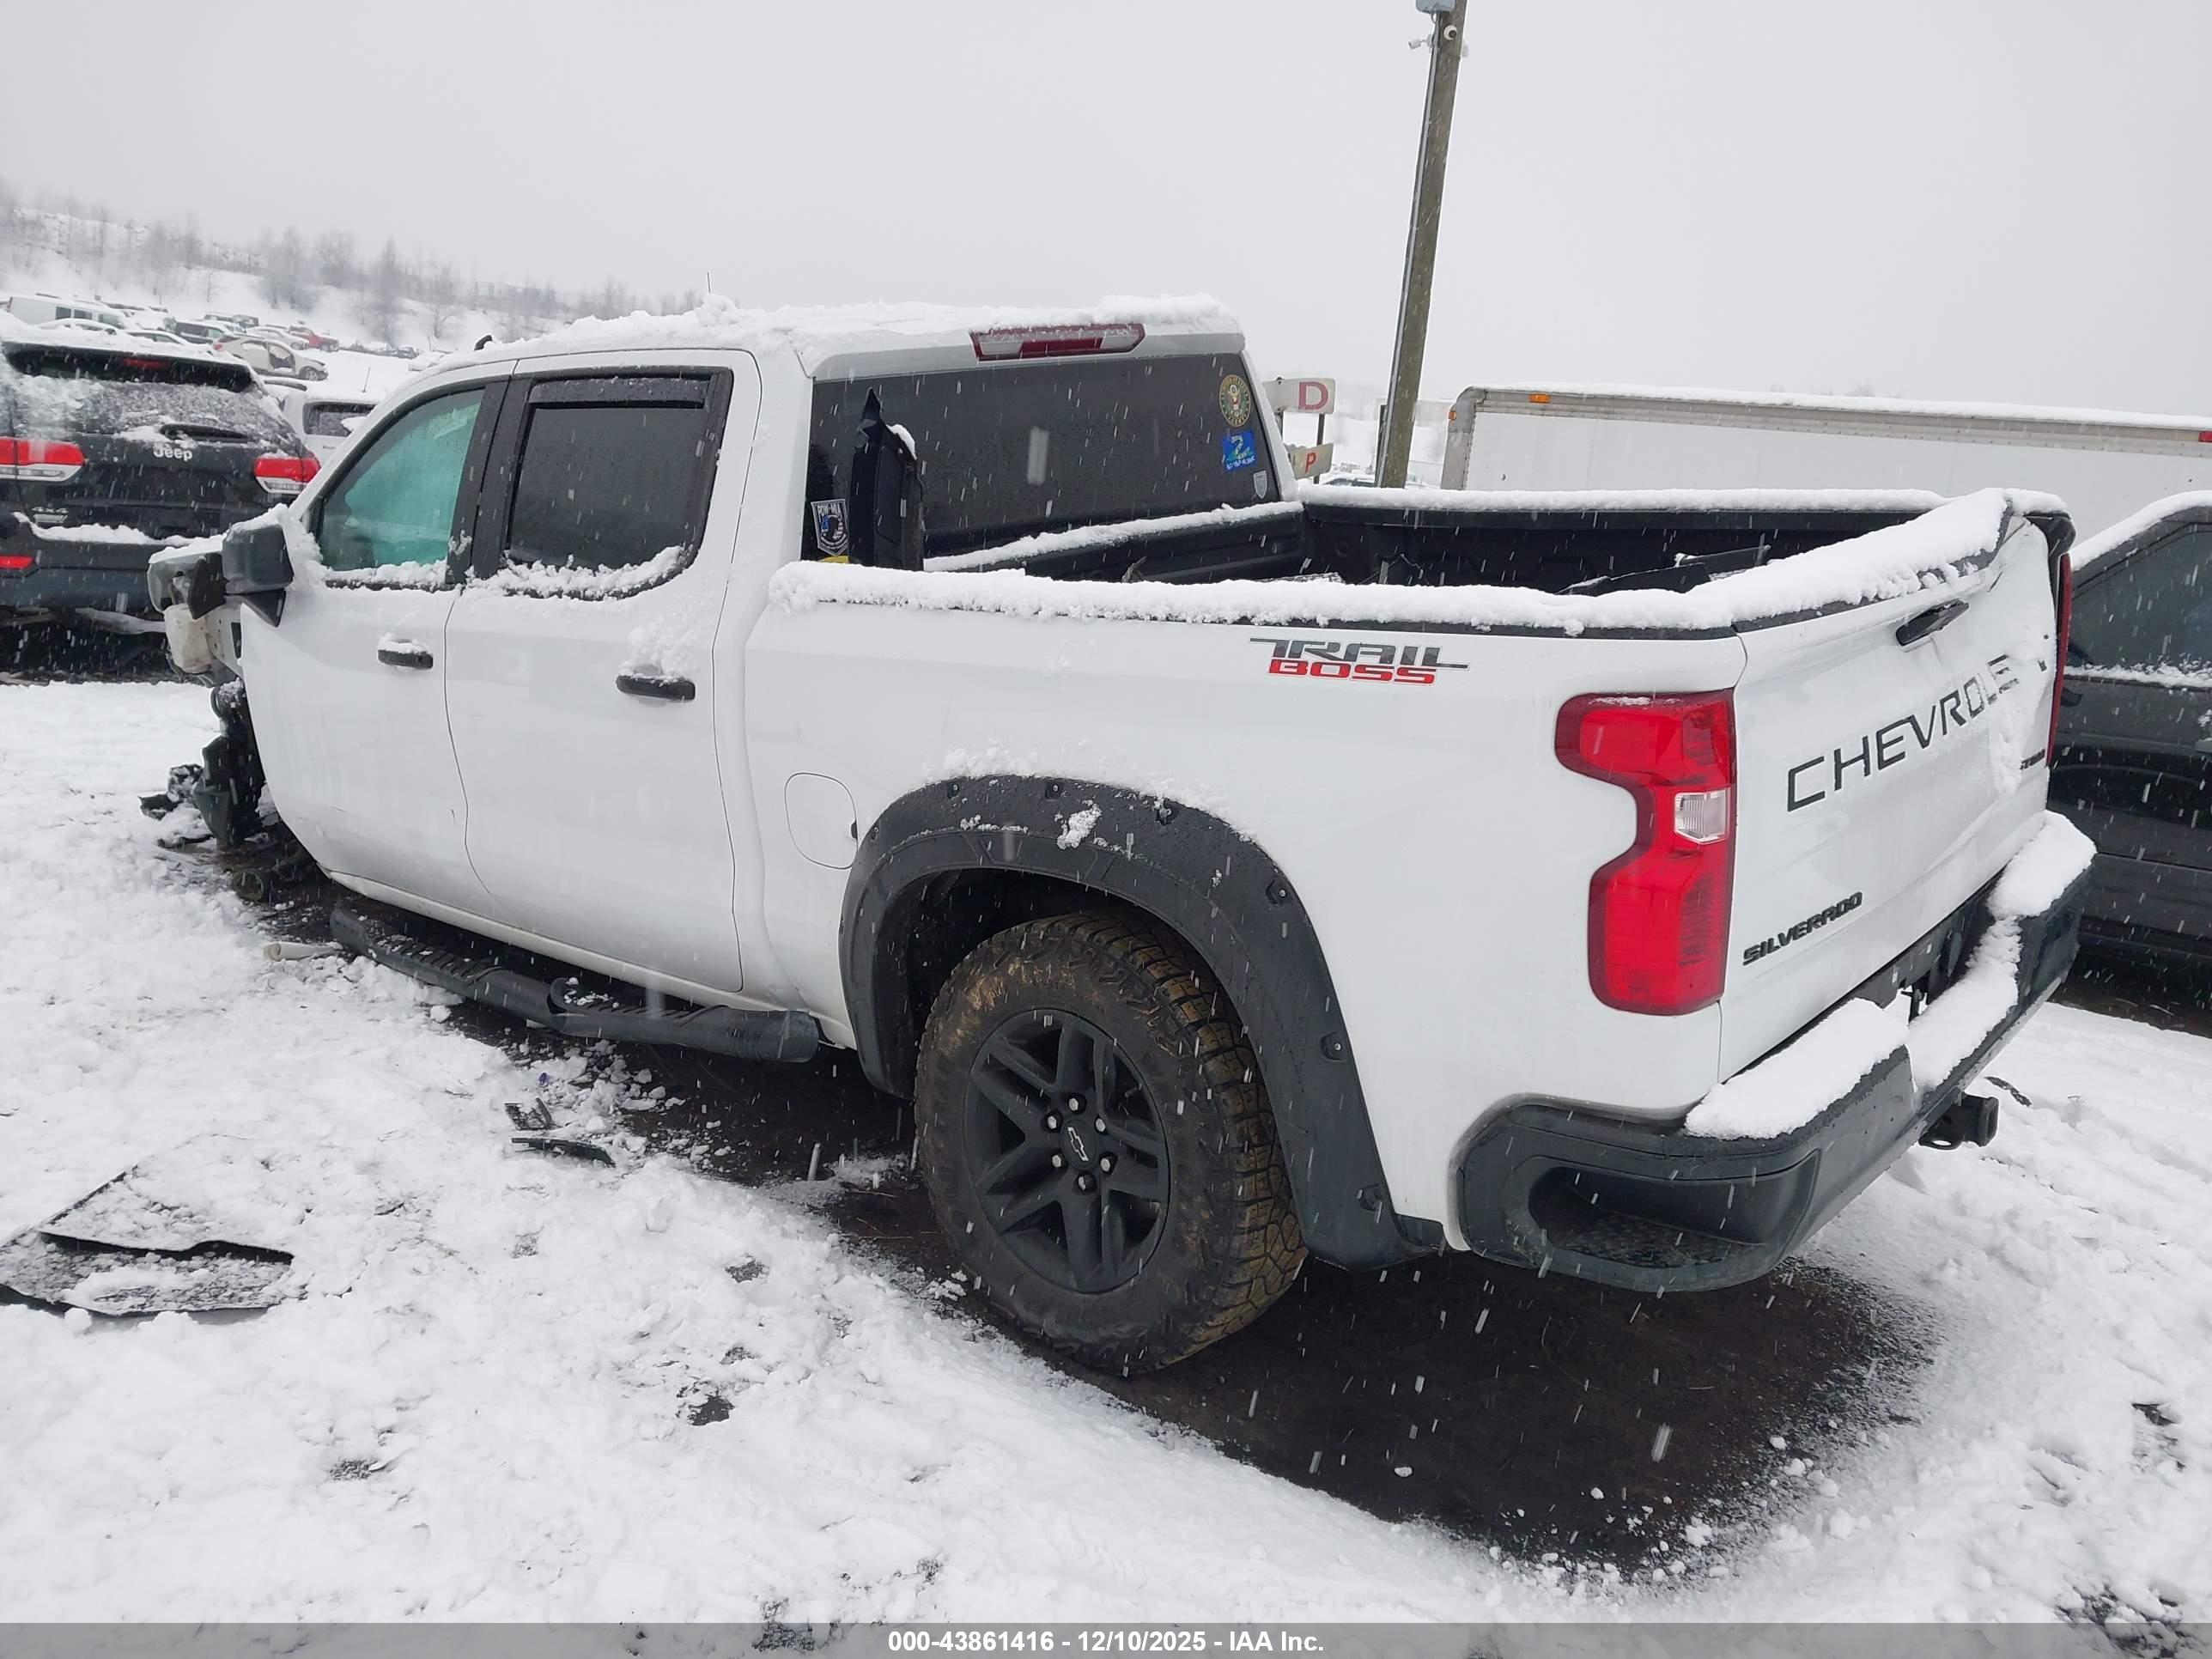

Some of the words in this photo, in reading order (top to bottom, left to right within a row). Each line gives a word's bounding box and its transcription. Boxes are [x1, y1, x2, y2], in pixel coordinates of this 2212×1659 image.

[1297, 381, 1328, 410] D
[153, 442, 193, 462] Jeep
[1304, 452, 1316, 474] P
[1250, 638, 1468, 668] TRAIL
[1268, 659, 1437, 684] BOSS
[1787, 653, 2020, 812] CHEVROLE
[1742, 891, 1863, 966] SILVERADO
